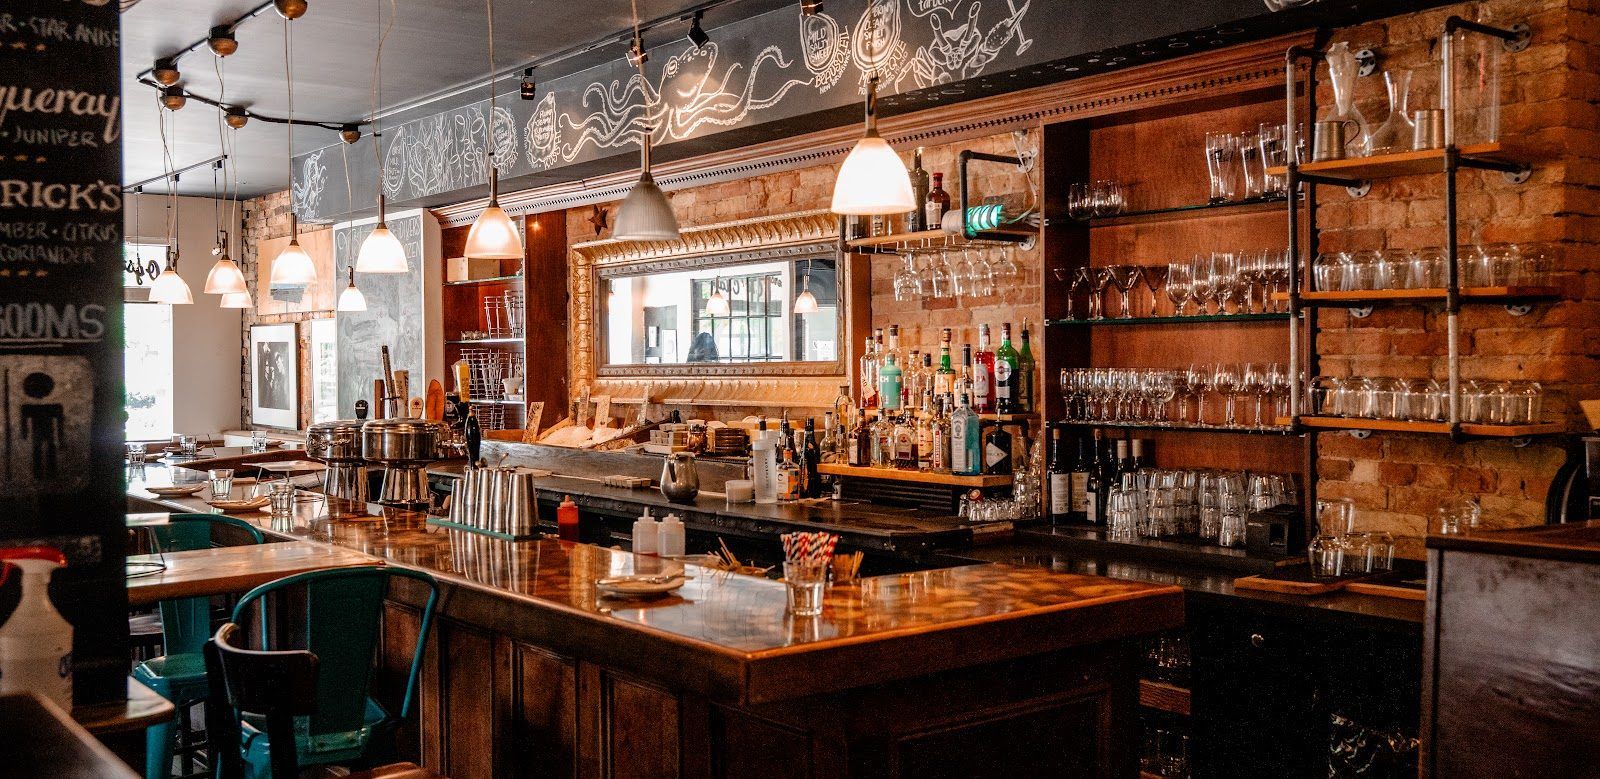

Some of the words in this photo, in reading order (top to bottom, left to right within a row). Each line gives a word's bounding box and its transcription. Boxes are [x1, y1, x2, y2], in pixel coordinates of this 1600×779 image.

[808, 28, 826, 43] MILD
[865, 37, 885, 51] FNISH
[13, 126, 98, 148] JUNIPER
[0, 179, 122, 212] RICK'S
[0, 301, 106, 339] OOMS
